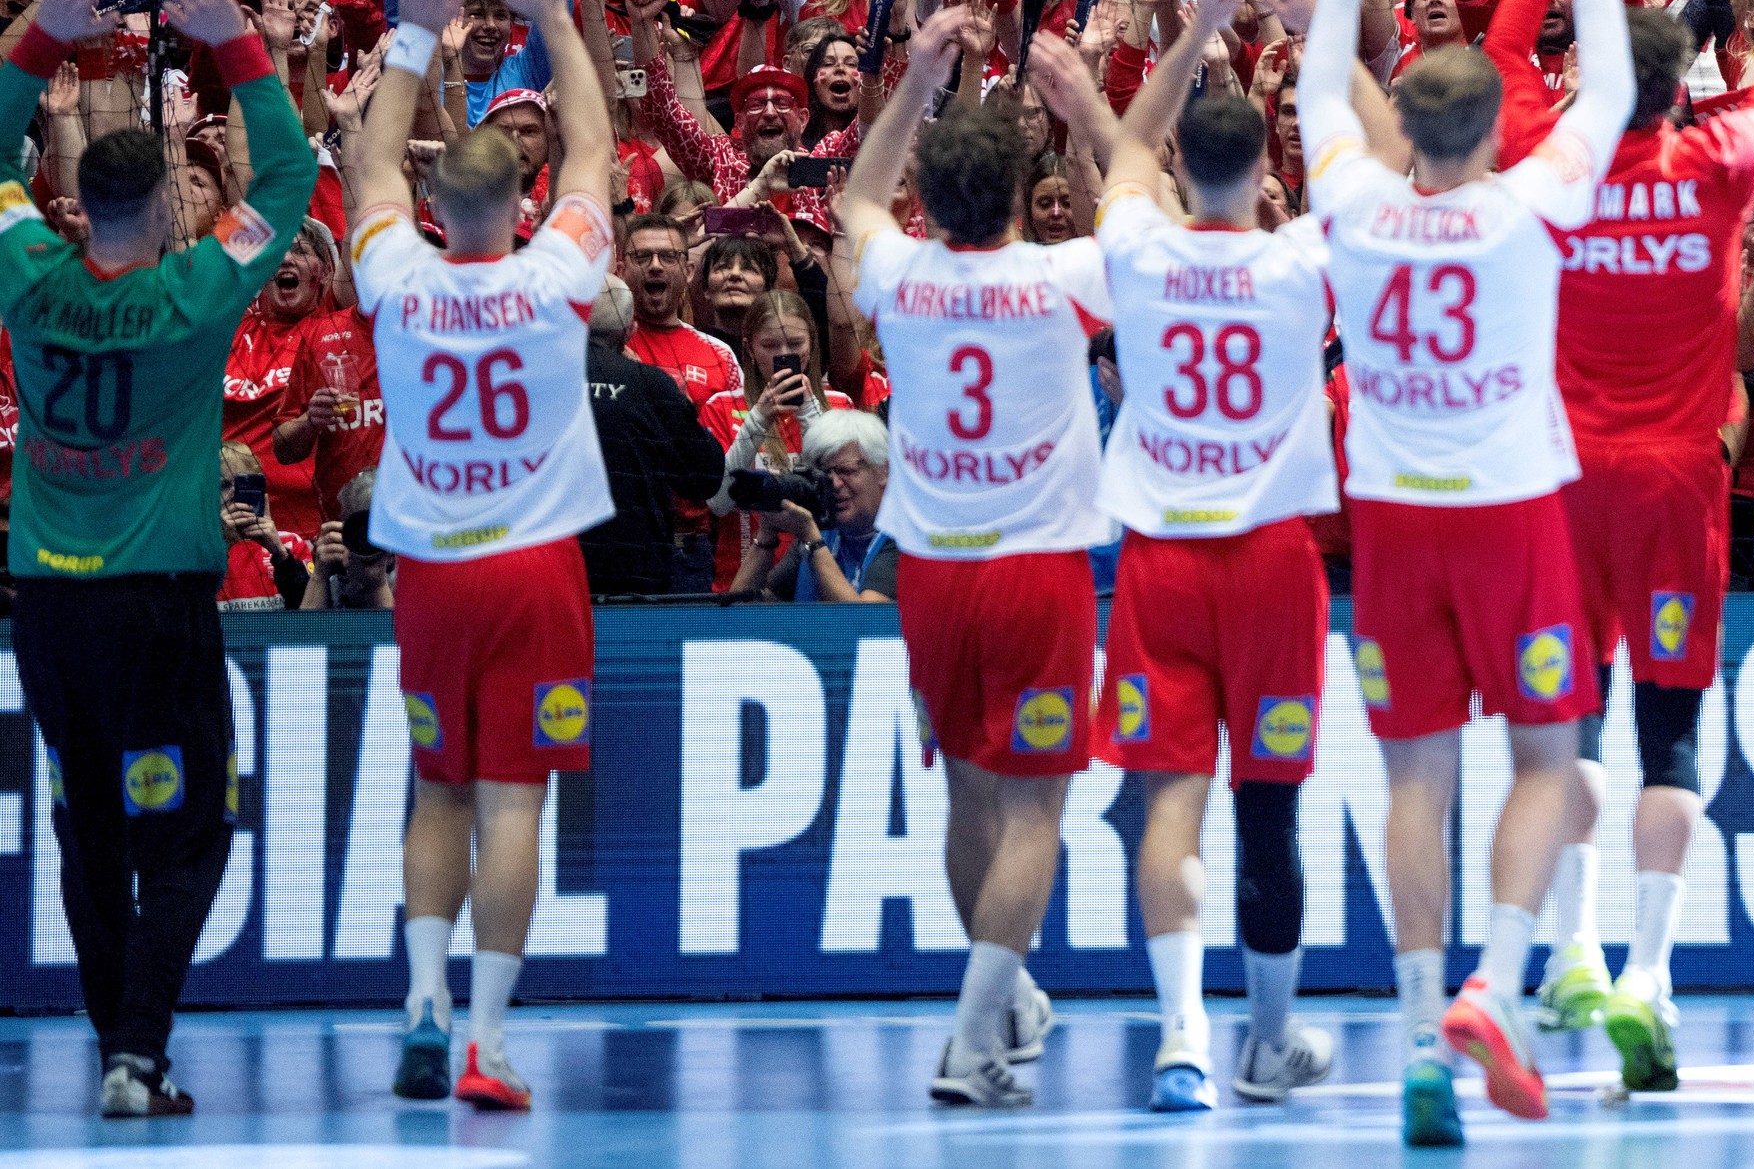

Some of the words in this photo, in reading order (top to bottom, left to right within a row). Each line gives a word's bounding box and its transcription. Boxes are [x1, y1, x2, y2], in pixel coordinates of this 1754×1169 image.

[869, 4, 883, 48] GRUNDFOS
[321, 331, 352, 343] NORLYS
[403, 294, 421, 329] P.
[430, 290, 535, 332] HANSEN
[1370, 263, 1477, 363] 43
[42, 342, 134, 440] 20
[421, 346, 531, 441] 26
[946, 342, 994, 442] 3
[1160, 320, 1264, 422] 38
